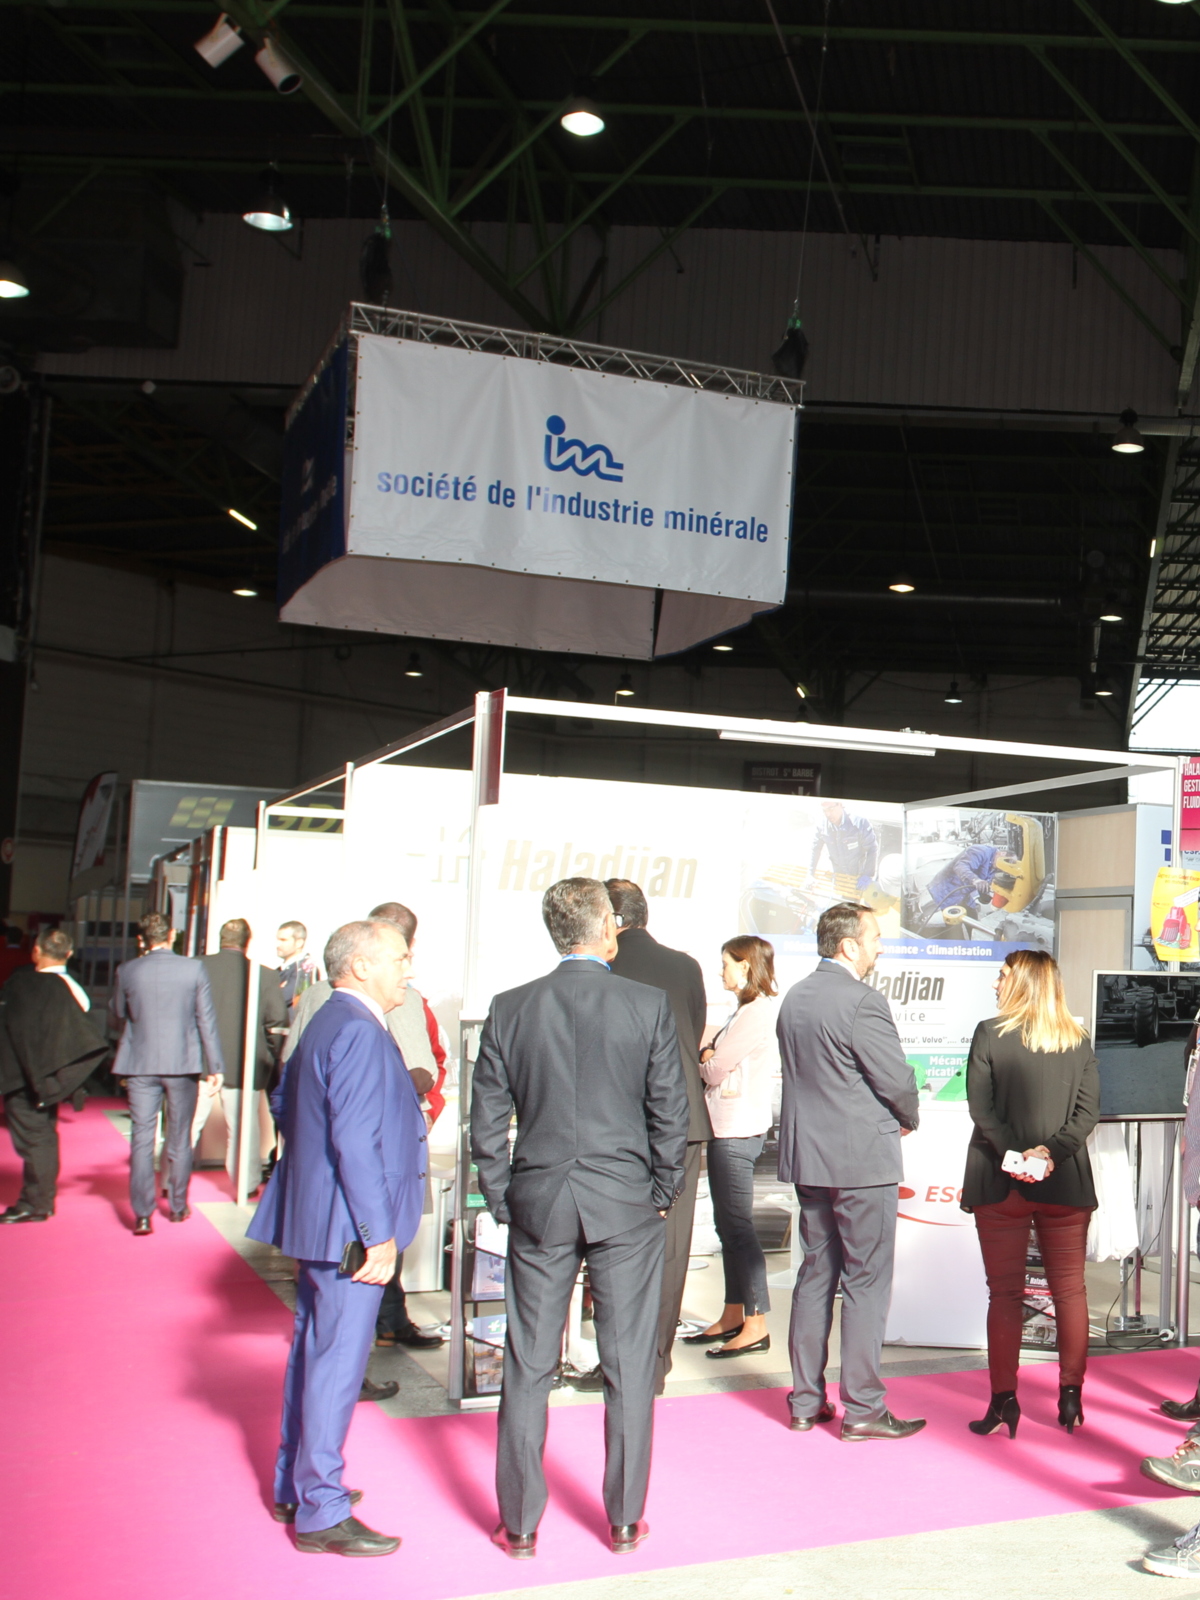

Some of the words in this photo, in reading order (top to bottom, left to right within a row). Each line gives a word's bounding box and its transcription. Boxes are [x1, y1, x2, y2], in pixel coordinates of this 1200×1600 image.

[377, 471, 477, 502] société
[487, 479, 516, 509] de
[526, 485, 654, 528] l'industrie
[664, 507, 769, 544] minérale
[751, 766, 779, 777] BISTROT
[792, 768, 814, 778] BARBE
[926, 944, 992, 957] Climatisation
[895, 1010, 927, 1022] vice
[929, 1055, 963, 1066] Mécan
